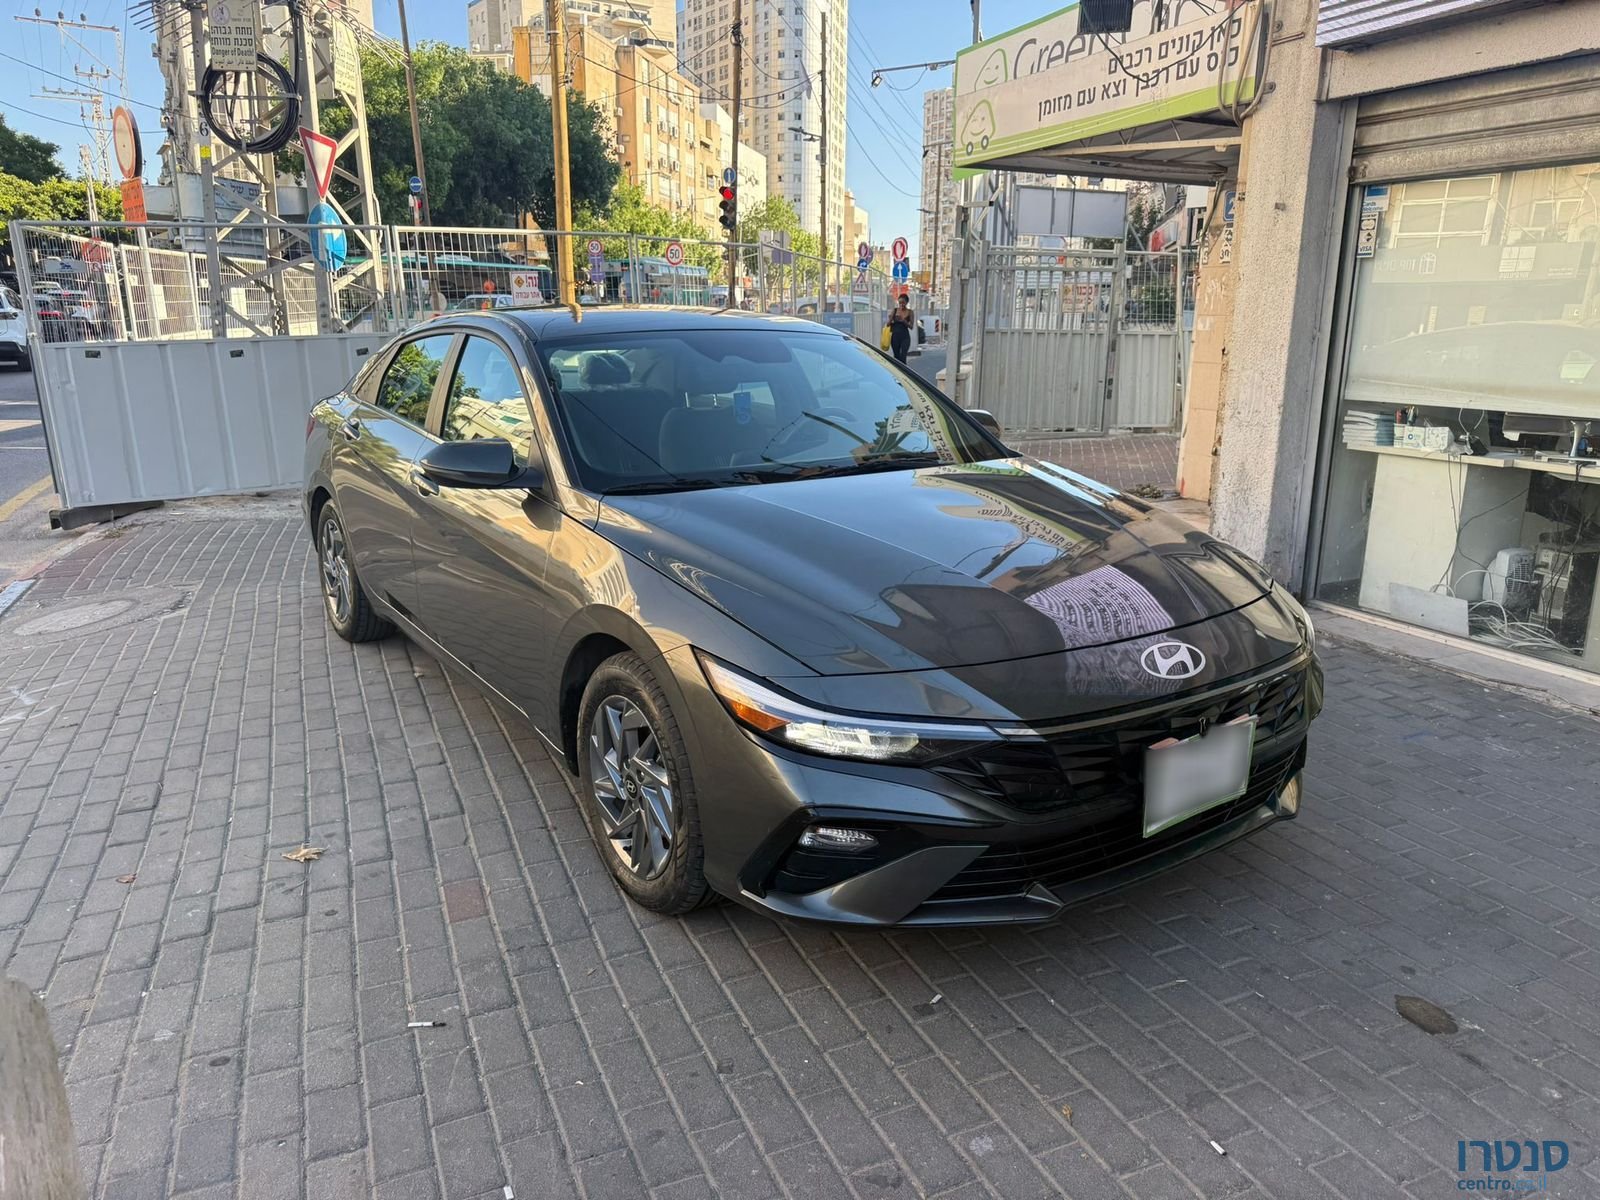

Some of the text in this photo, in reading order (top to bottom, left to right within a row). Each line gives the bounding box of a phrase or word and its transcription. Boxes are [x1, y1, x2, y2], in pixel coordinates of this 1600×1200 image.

[210, 25, 253, 36] מתח גבוה!
[211, 47, 230, 58] Danger
[231, 47, 237, 56] of
[1157, 29, 1204, 61] קונים
[1107, 46, 1153, 76] רכבים
[1175, 57, 1200, 81] עם
[1206, 46, 1240, 72] כס
[1076, 86, 1096, 108] עם
[1101, 78, 1127, 101] וצא
[1038, 93, 1073, 122] מזומן
[590, 243, 599, 252] 50
[669, 248, 680, 260] 50
